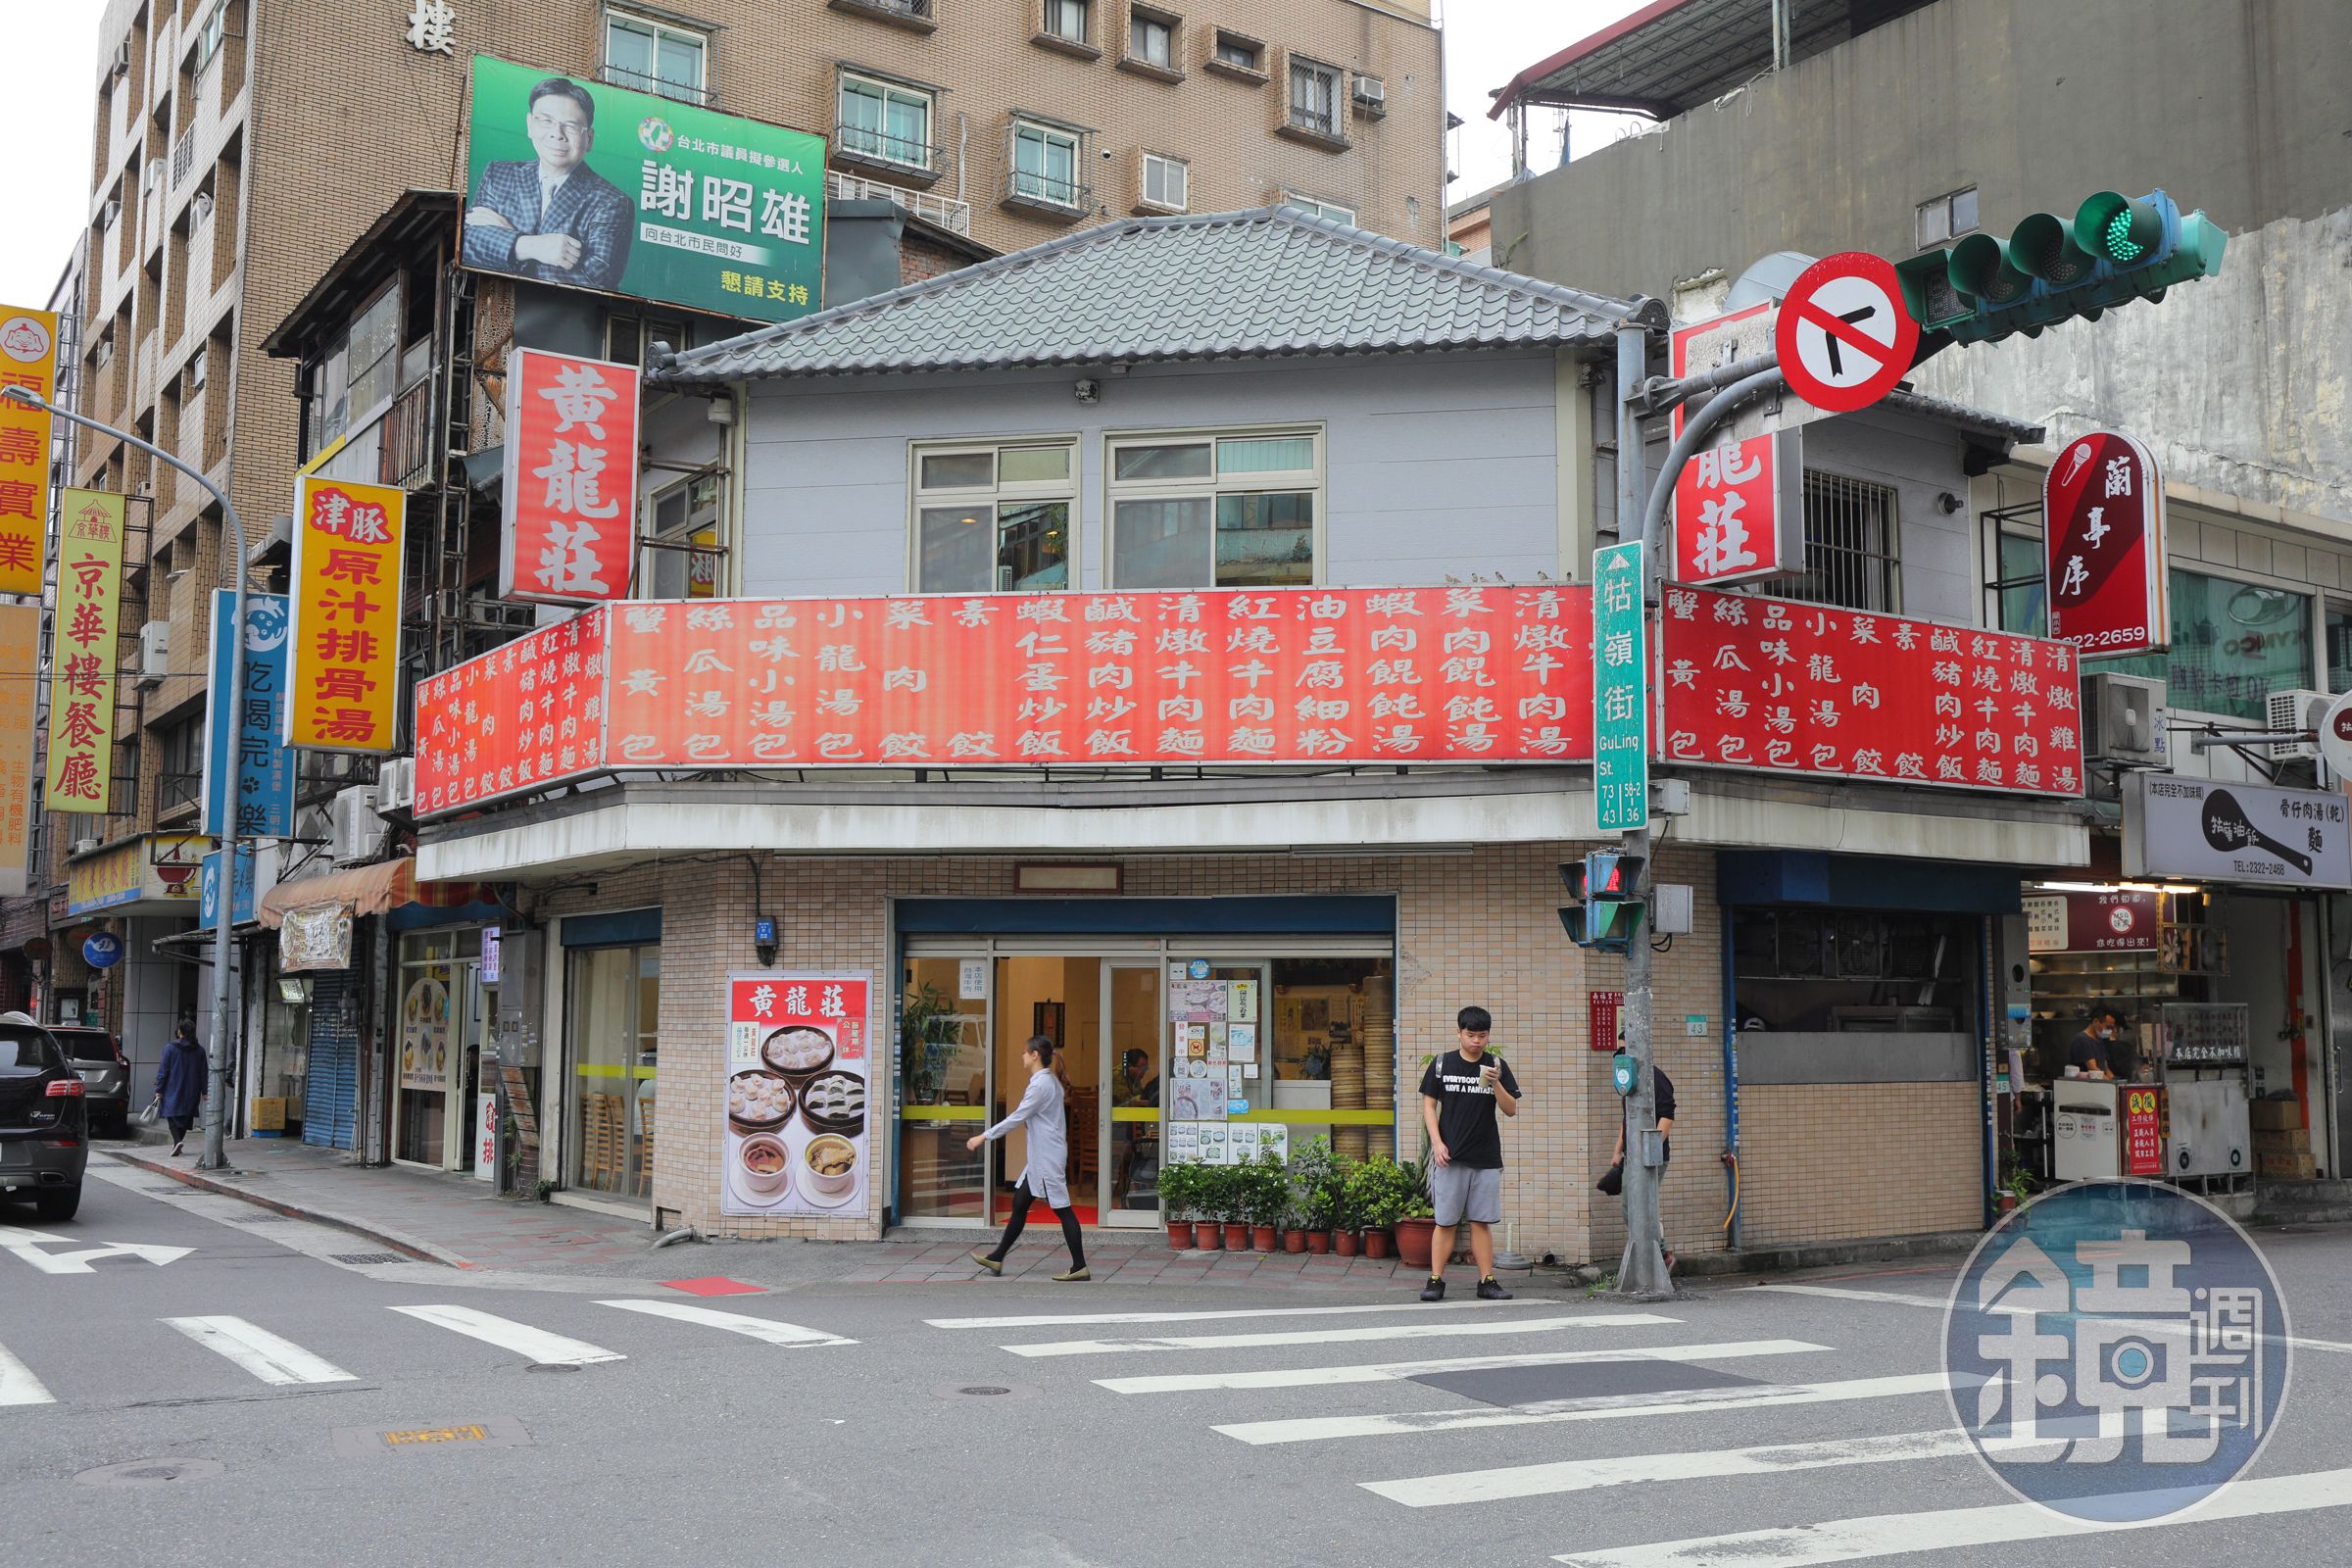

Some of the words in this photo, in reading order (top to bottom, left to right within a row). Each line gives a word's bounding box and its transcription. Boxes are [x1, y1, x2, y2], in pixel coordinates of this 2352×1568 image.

[407, 0, 456, 56] 樓
[639, 159, 810, 245] 謝昭雄
[677, 134, 804, 175] 台北市議員擬參選人
[645, 227, 743, 258] 向台北市民問好
[720, 270, 809, 306] 懇請支持
[0, 371, 45, 572] 福壽實業
[315, 494, 389, 545] 津豚
[532, 365, 619, 598] 黃龍莊
[2059, 456, 2132, 596] 蘭亭序
[54, 552, 111, 801] 京華樓餐廳
[313, 549, 383, 743] 原汁排骨湯
[517, 637, 538, 783] 鹹豬肉炒飯
[538, 631, 559, 777] 紅燒牛肉麵
[559, 619, 580, 771] 清燉牛肉麵
[581, 610, 604, 765] 清燉雞湯
[618, 606, 667, 760] 蟹黃包
[683, 604, 735, 760] 絲瓜湯包
[747, 604, 801, 760] 品味小湯包
[813, 603, 867, 760] 小龍湯包
[878, 601, 934, 759] 菜肉餃
[946, 599, 1001, 758] 素餃
[1014, 598, 1072, 757] 蝦仁蛋炒飯
[1084, 596, 1142, 756] 鹹豬肉炒飯
[1154, 595, 1211, 756] 清燉牛肉麵
[1225, 594, 1281, 755] 紅燒牛肉麵
[1295, 594, 1354, 757] 油豆腐細粉
[1366, 591, 1426, 755] 蝦肉餛飩湯
[1439, 588, 1502, 753] 菜肉餛飩湯
[1513, 591, 1573, 755] 清燉牛肉湯
[1604, 578, 1635, 722] 牯嶺街
[1665, 589, 1705, 760] 蟹黃包
[1712, 597, 1754, 764] 絲瓜湯包
[1759, 604, 1800, 768] 品味小湯包
[1805, 612, 1843, 772] 小龍湯包
[1849, 615, 1887, 776] 菜肉餃
[1891, 622, 1928, 779] 素餃
[1930, 627, 1969, 782] 鹹豬肉炒飯
[1971, 634, 2004, 786] 紅燒牛肉麵
[2063, 625, 2146, 651] 22-2659
[431, 678, 446, 808] 絲瓜湯包
[447, 672, 463, 805] 品味小湯包
[464, 665, 478, 801] 小龍湯包
[480, 656, 498, 796] 菜肉餃
[498, 649, 516, 791] 素餃
[1599, 734, 1639, 754] GuLing
[1599, 760, 1614, 776] St.
[2009, 640, 2042, 790] 清燉牛肉麵
[2045, 645, 2079, 793] 清燉雞湯
[2154, 715, 2166, 754] 冰點
[8, 760, 25, 846] 生物有機肥料
[1601, 785, 1615, 800] 73
[1624, 782, 1641, 798] 58-2
[1602, 808, 1616, 824] 43
[1626, 808, 1640, 822] 36
[2279, 798, 2345, 823] 骨仔肉湯(乾)
[2307, 826, 2324, 854] 麵
[2233, 860, 2285, 875] TEL:2322-2468
[749, 985, 847, 1018] 黃龍莊
[1690, 1023, 1703, 1034] 43
[1443, 1075, 1481, 1085] EVERYBODY
[1467, 1085, 1494, 1096] FANTAS
